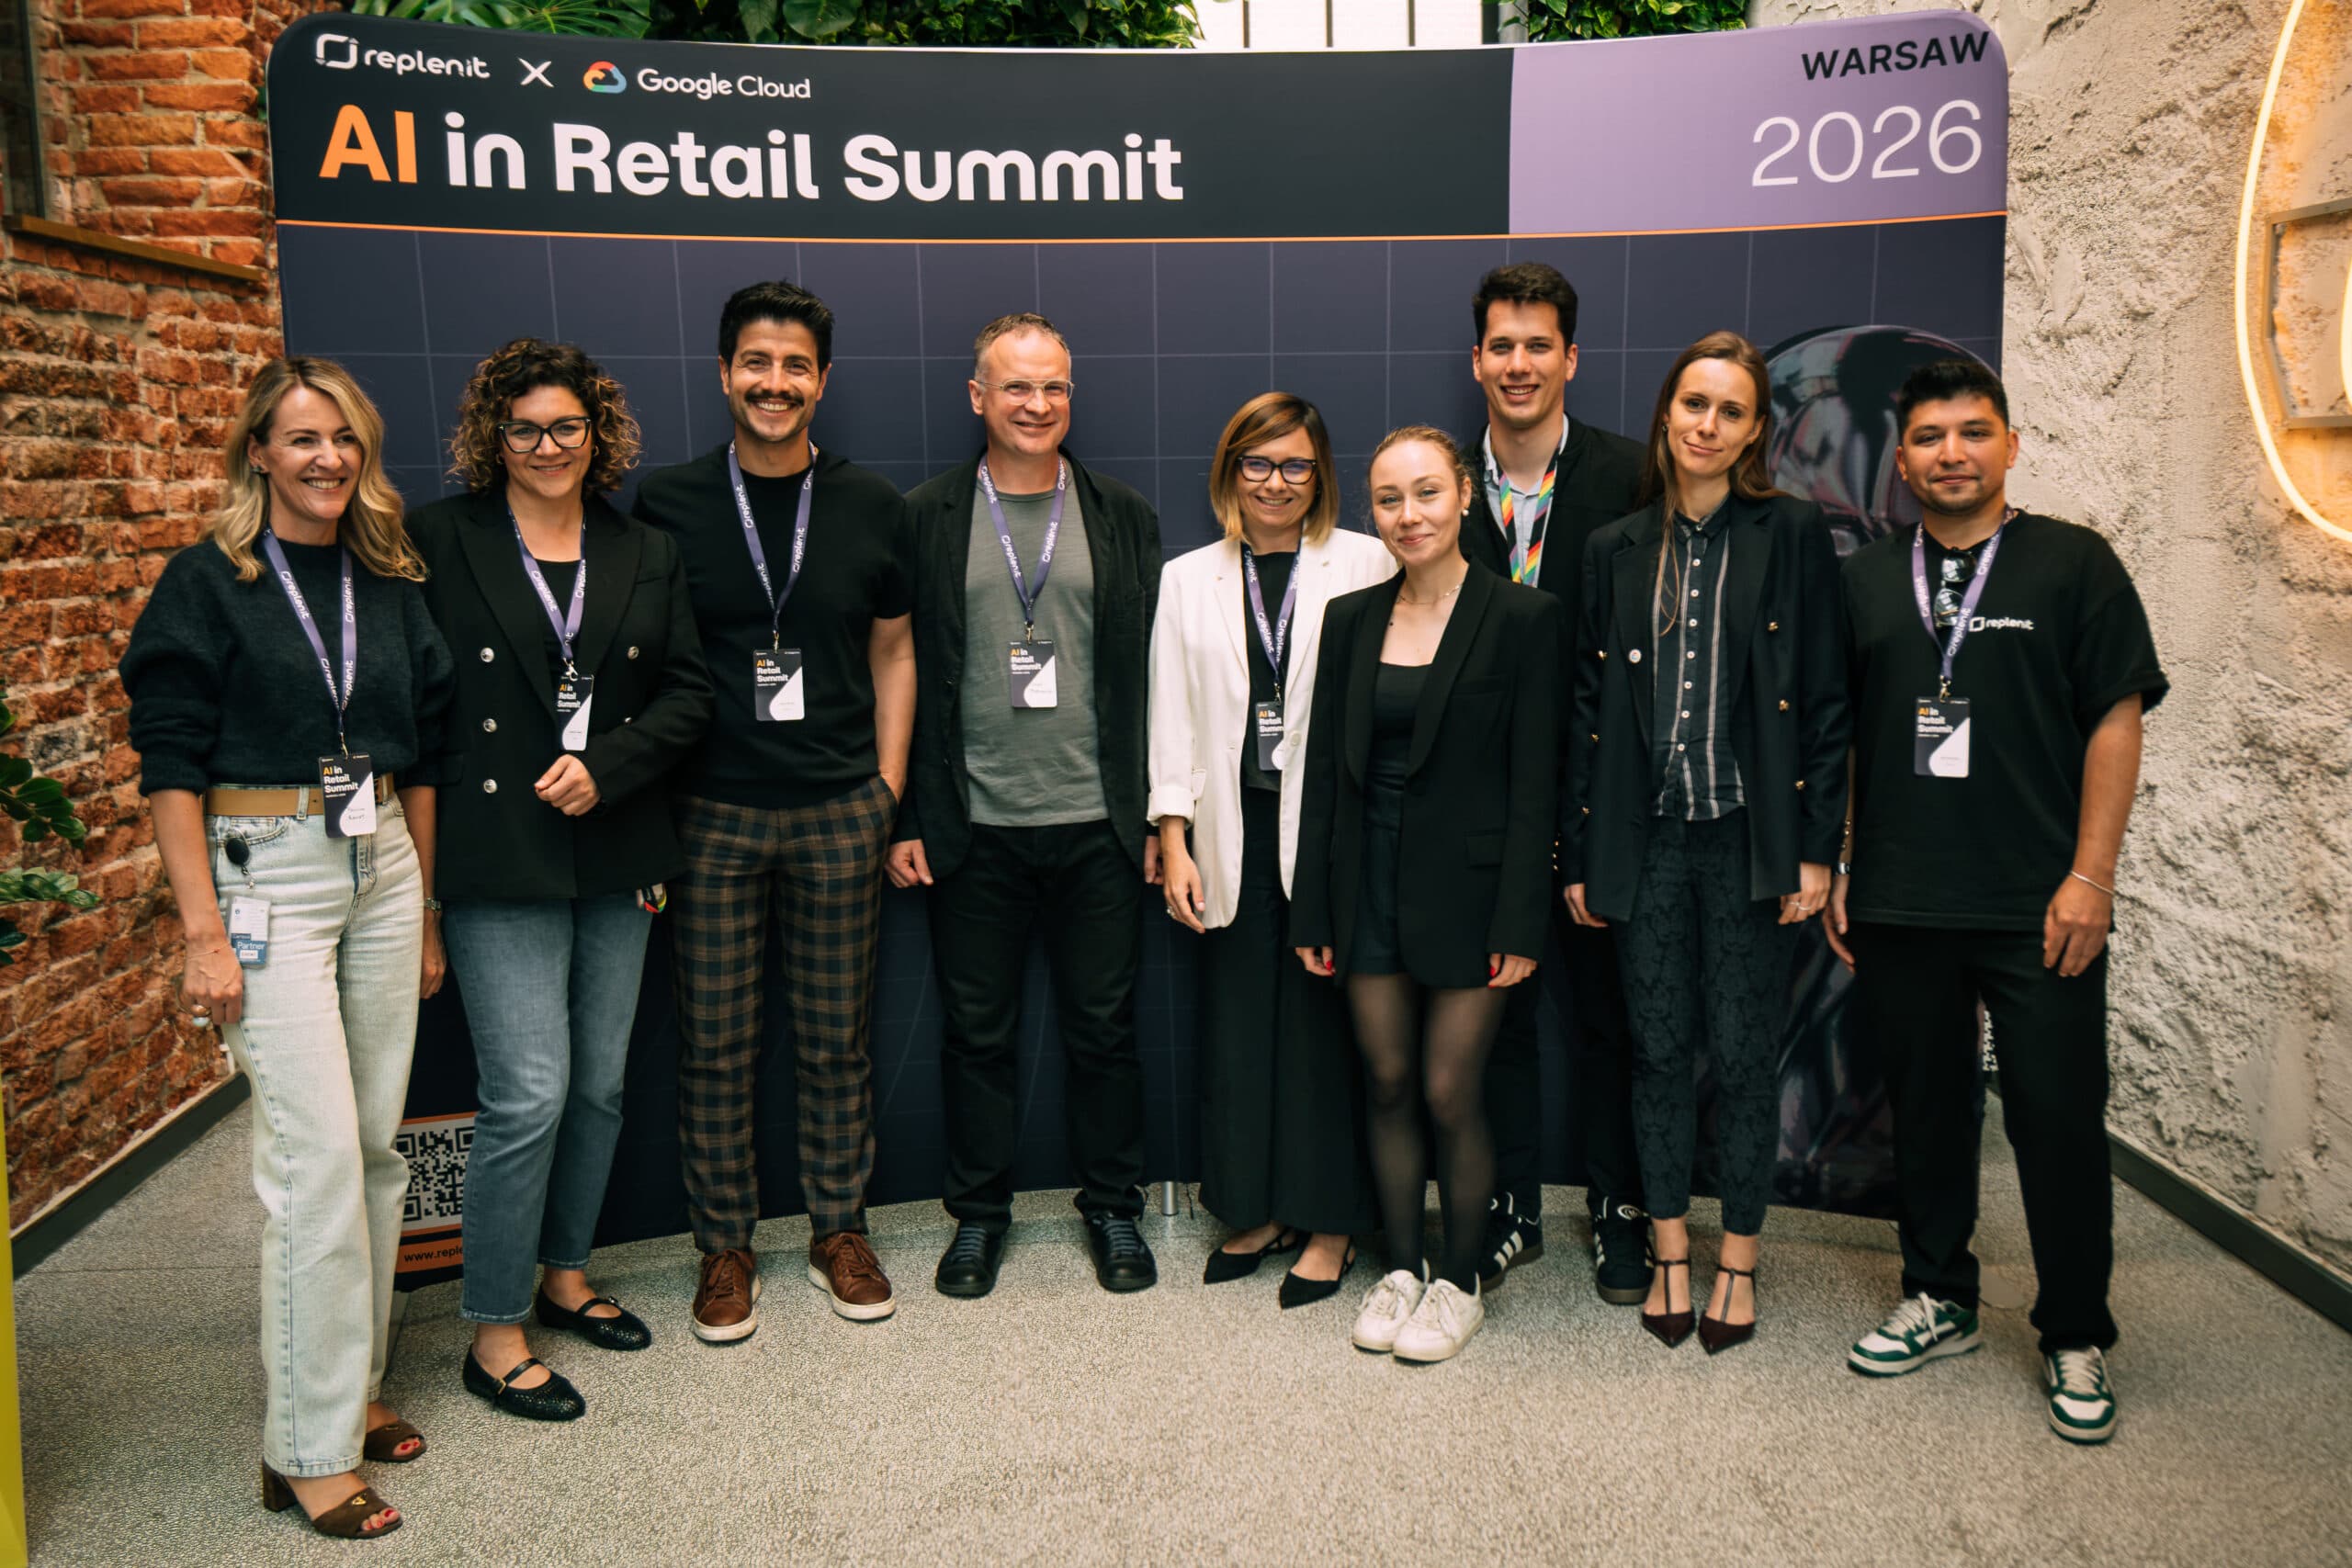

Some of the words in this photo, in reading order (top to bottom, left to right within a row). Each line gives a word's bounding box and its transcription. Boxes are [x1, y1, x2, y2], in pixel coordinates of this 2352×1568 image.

[1801, 31, 1990, 81] WARSAW
[364, 49, 491, 79] replenit
[637, 68, 733, 100] Google
[737, 74, 811, 98] Cloud
[318, 104, 418, 184] AI
[445, 111, 526, 189] in
[553, 122, 820, 199] Retail
[842, 132, 1184, 202] Summit
[1751, 99, 1984, 186] 2026
[794, 527, 806, 563] replenit
[1005, 543, 1022, 578] replenit
[286, 580, 310, 619] replenit
[344, 576, 355, 613] replenit
[1951, 607, 1972, 649] replenit
[1985, 616, 2034, 630] replenit
[1020, 648, 1028, 656] in
[756, 666, 781, 674] Retail
[756, 674, 788, 682] Summit
[1917, 707, 1929, 716] AI
[1929, 706, 1939, 716] in
[322, 766, 333, 775] AI
[334, 765, 343, 773] in
[323, 773, 350, 784] Retail
[324, 782, 359, 794] Summit
[237, 942, 266, 950] Partner
